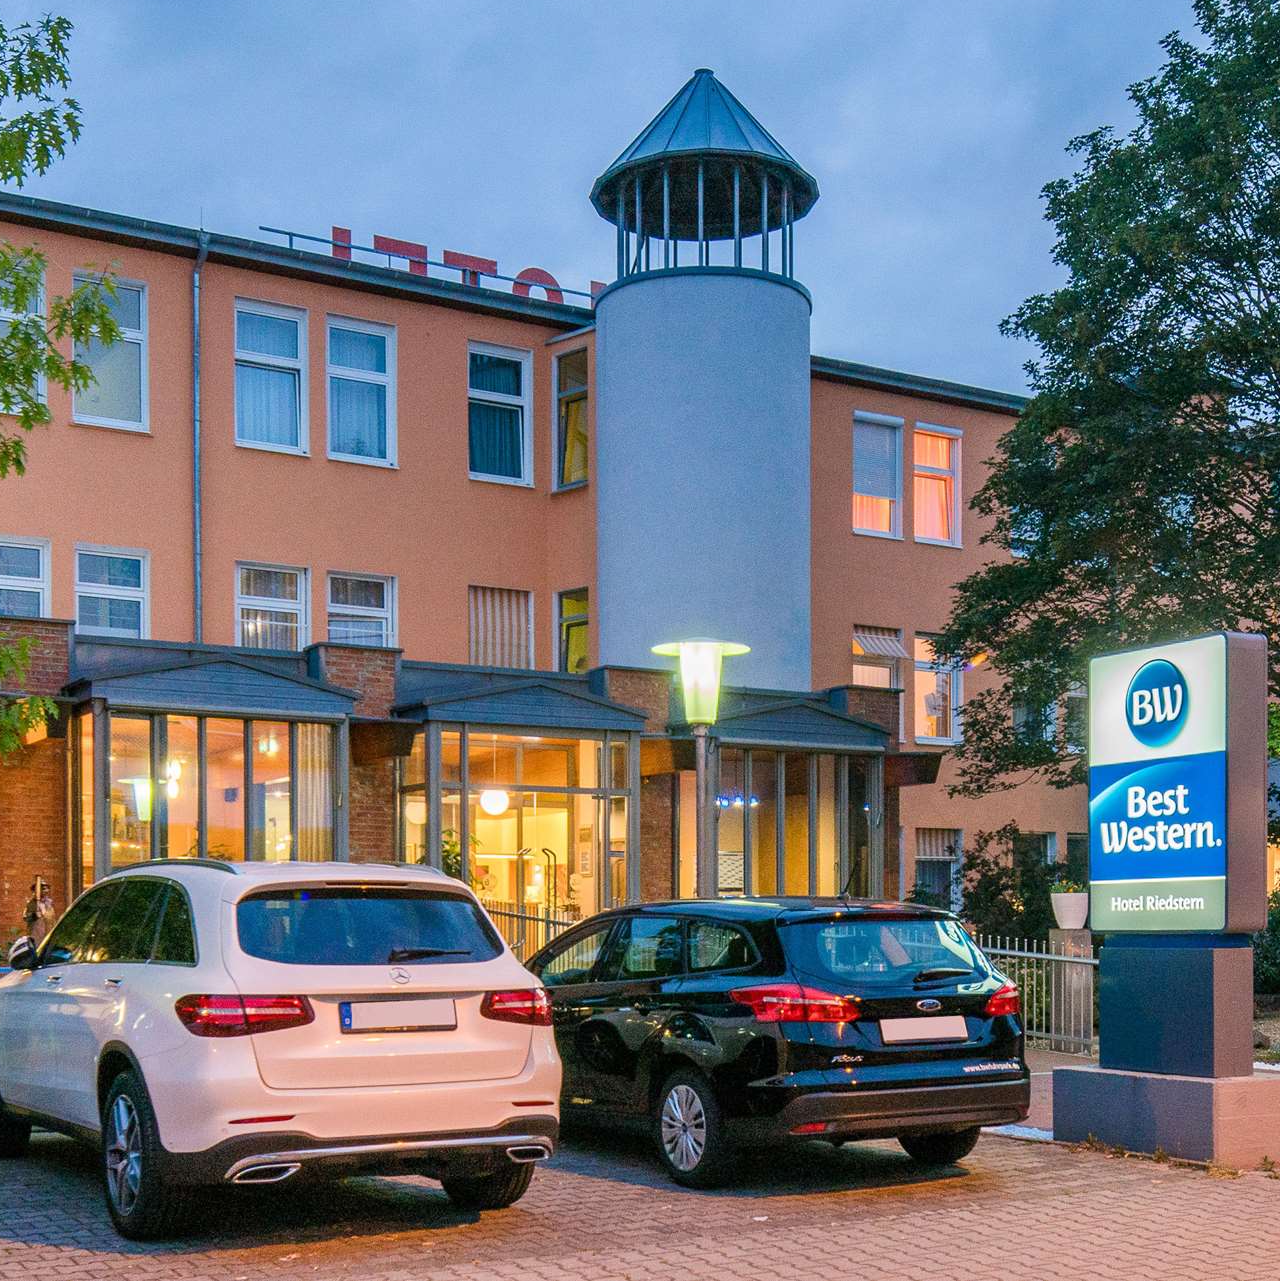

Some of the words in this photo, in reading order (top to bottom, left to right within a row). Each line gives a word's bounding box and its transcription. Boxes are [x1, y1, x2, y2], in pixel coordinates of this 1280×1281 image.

[1132, 684, 1183, 726] BW
[1127, 784, 1190, 818] Best
[1100, 820, 1223, 854] Western.
[1111, 895, 1144, 912] Hotel
[1146, 894, 1204, 911] Riedstern
